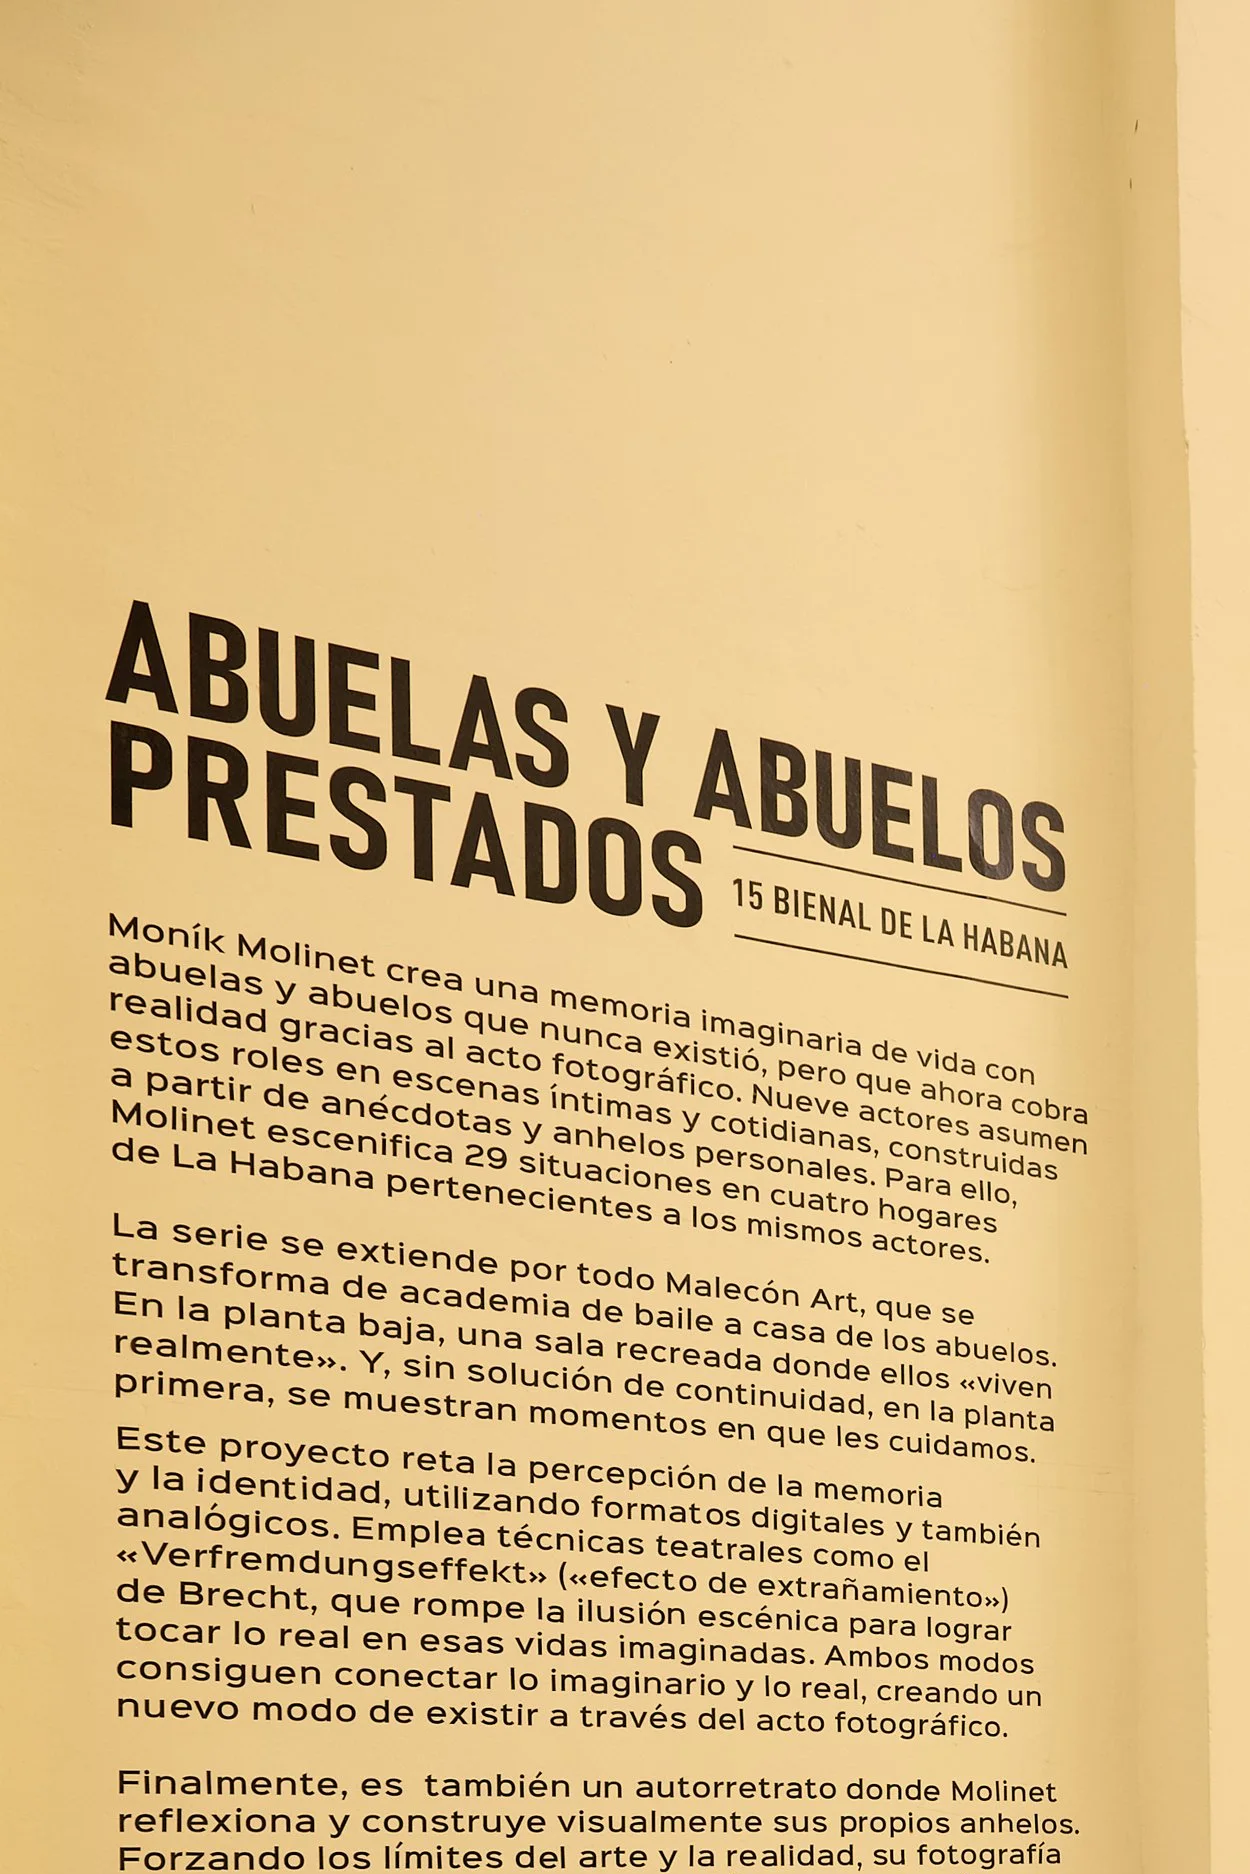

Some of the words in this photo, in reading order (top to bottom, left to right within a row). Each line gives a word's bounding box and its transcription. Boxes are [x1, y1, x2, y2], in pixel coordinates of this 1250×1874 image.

[104, 599, 570, 789] ABUELAS
[605, 703, 661, 807] Y
[693, 727, 1066, 892] ABUELOS
[110, 719, 703, 928] PRESTADOS
[732, 878, 763, 911] 15
[774, 885, 872, 932] BIENAL
[881, 906, 913, 940] DE
[922, 914, 955, 947] LA
[963, 922, 1068, 969] HABANA
[109, 912, 225, 954] Moník
[238, 933, 376, 978] Molinet
[386, 963, 463, 992] crea
[475, 977, 538, 1004] una
[550, 989, 690, 1029] memoria
[701, 1008, 862, 1057] imaginaria
[871, 1039, 908, 1064] de
[916, 1048, 976, 1076] vida
[985, 1063, 1035, 1086] con
[110, 991, 267, 1033] realidad
[279, 1017, 414, 1054] gracias
[425, 1036, 454, 1060] al
[466, 1045, 542, 1072] acto
[551, 1052, 742, 1103] fotográfico.
[751, 1083, 849, 1118] Nueve
[858, 1104, 970, 1137] actores
[978, 1123, 1088, 1155] asumen
[110, 1067, 132, 1088] a
[146, 1071, 252, 1103] partir
[263, 1083, 309, 1110] de
[321, 1093, 512, 1136] anécdotas
[522, 1121, 543, 1145] y
[553, 1125, 685, 1160] anhelos
[696, 1145, 876, 1186] personales.
[885, 1167, 951, 1197] Para
[960, 1179, 1017, 1209] ello,
[111, 1137, 160, 1165] de
[173, 1143, 217, 1172] La
[230, 1150, 374, 1190] Habana
[387, 1173, 653, 1222] pertenecientes
[663, 1207, 681, 1226] a
[692, 1205, 737, 1233] los
[747, 1215, 863, 1248] mismos
[872, 1233, 990, 1264] actores.
[111, 1252, 329, 1296] transforma
[342, 1274, 388, 1301] de
[400, 1285, 570, 1319] academia
[582, 1298, 624, 1323] de
[635, 1302, 714, 1332] baile
[724, 1317, 742, 1336] a
[753, 1320, 825, 1344] casa
[836, 1324, 873, 1348] de
[884, 1328, 926, 1354] los
[935, 1335, 1057, 1368] abuelos.
[115, 1333, 347, 1372] realmente».
[359, 1349, 391, 1380] Y,
[403, 1354, 455, 1380] sin
[467, 1362, 612, 1394] solución
[624, 1373, 665, 1398] de
[675, 1382, 873, 1421] continuidad,
[883, 1401, 920, 1420] en
[930, 1399, 954, 1423] la
[964, 1404, 1055, 1432] planta
[117, 1425, 206, 1455] Este
[220, 1438, 390, 1468] proyecto
[403, 1450, 475, 1474] reta
[487, 1451, 516, 1477] la
[529, 1460, 716, 1491] percepción
[727, 1470, 767, 1495] de
[778, 1473, 803, 1498] la
[814, 1481, 942, 1509] memoria
[116, 1540, 547, 1584] «Verfremdungseffekt»
[558, 1561, 697, 1592] («efecto
[708, 1571, 747, 1595] de
[758, 1576, 1009, 1614] extrañamiento»)
[117, 1502, 340, 1540] analógicos.
[352, 1515, 485, 1549] Emplea
[497, 1523, 645, 1555] técnicas
[655, 1535, 803, 1564] teatrales
[813, 1548, 894, 1570] como
[904, 1550, 929, 1573] el
[116, 1577, 165, 1604] de
[180, 1580, 318, 1616] Brecht,
[330, 1593, 400, 1618] que
[413, 1597, 525, 1624] rompe
[537, 1597, 565, 1624] la
[577, 1597, 686, 1626] ilusión
[698, 1604, 838, 1633] escénica
[849, 1617, 916, 1639] para
[927, 1616, 1012, 1645] lograr
[116, 1657, 321, 1689] consiguen
[334, 1666, 498, 1690] conectar
[510, 1666, 539, 1691] lo
[551, 1668, 726, 1699] imaginario
[735, 1679, 755, 1702] y
[764, 1674, 791, 1698] lo
[802, 1678, 867, 1705] real,
[877, 1683, 998, 1705] creando
[1008, 1689, 1042, 1707] un
[118, 1769, 348, 1801] Finalmente,
[361, 1777, 403, 1797] es
[424, 1771, 570, 1798] también
[583, 1780, 623, 1799] un
[635, 1776, 837, 1800] autorretrato
[846, 1777, 940, 1802] donde
[951, 1779, 1058, 1803] Molinet
[119, 1845, 305, 1871] Forzando
[318, 1845, 371, 1870] los
[384, 1841, 503, 1870] límites
[515, 1845, 566, 1869] del
[579, 1846, 648, 1868] arte
[658, 1849, 678, 1873] y
[689, 1844, 715, 1867] la
[727, 1843, 863, 1872] realidad,
[873, 1848, 906, 1866] su
[916, 1841, 1061, 1870] fotografía
